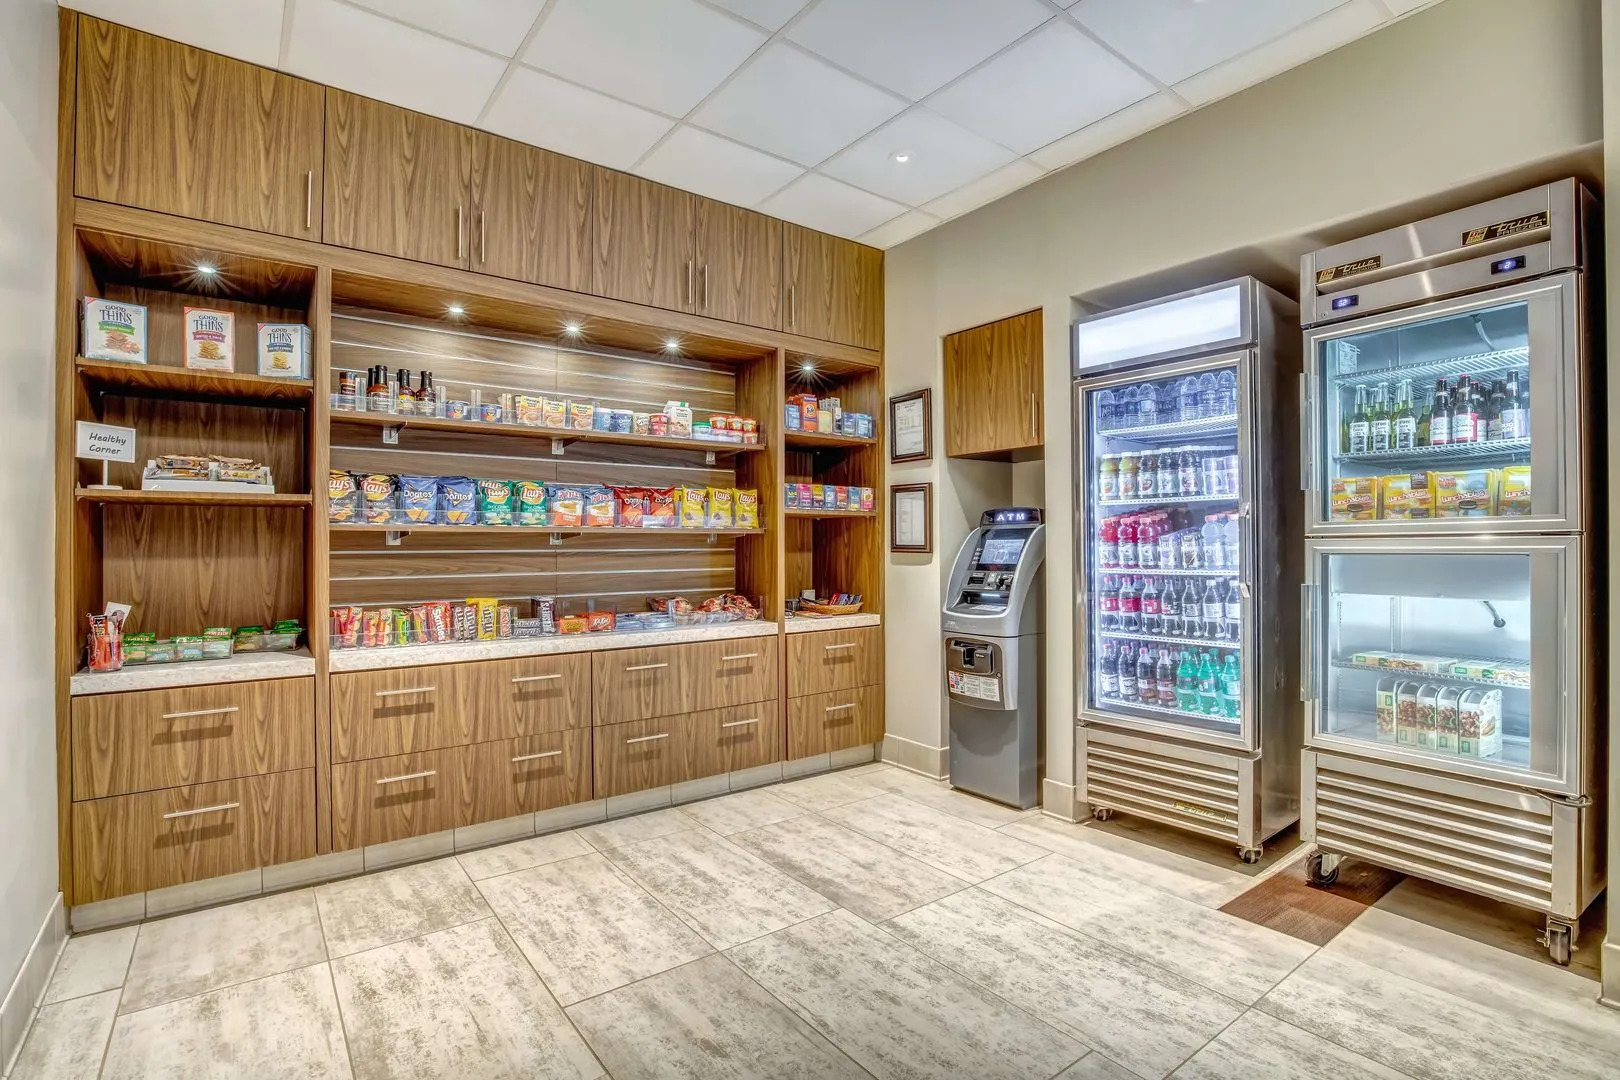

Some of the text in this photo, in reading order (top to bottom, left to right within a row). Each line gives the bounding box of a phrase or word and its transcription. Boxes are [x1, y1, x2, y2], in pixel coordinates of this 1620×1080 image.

[89, 432, 127, 446] Healthy
[89, 444, 121, 454] Corner
[996, 513, 1026, 521] ATM
[432, 608, 446, 641] Skittles
